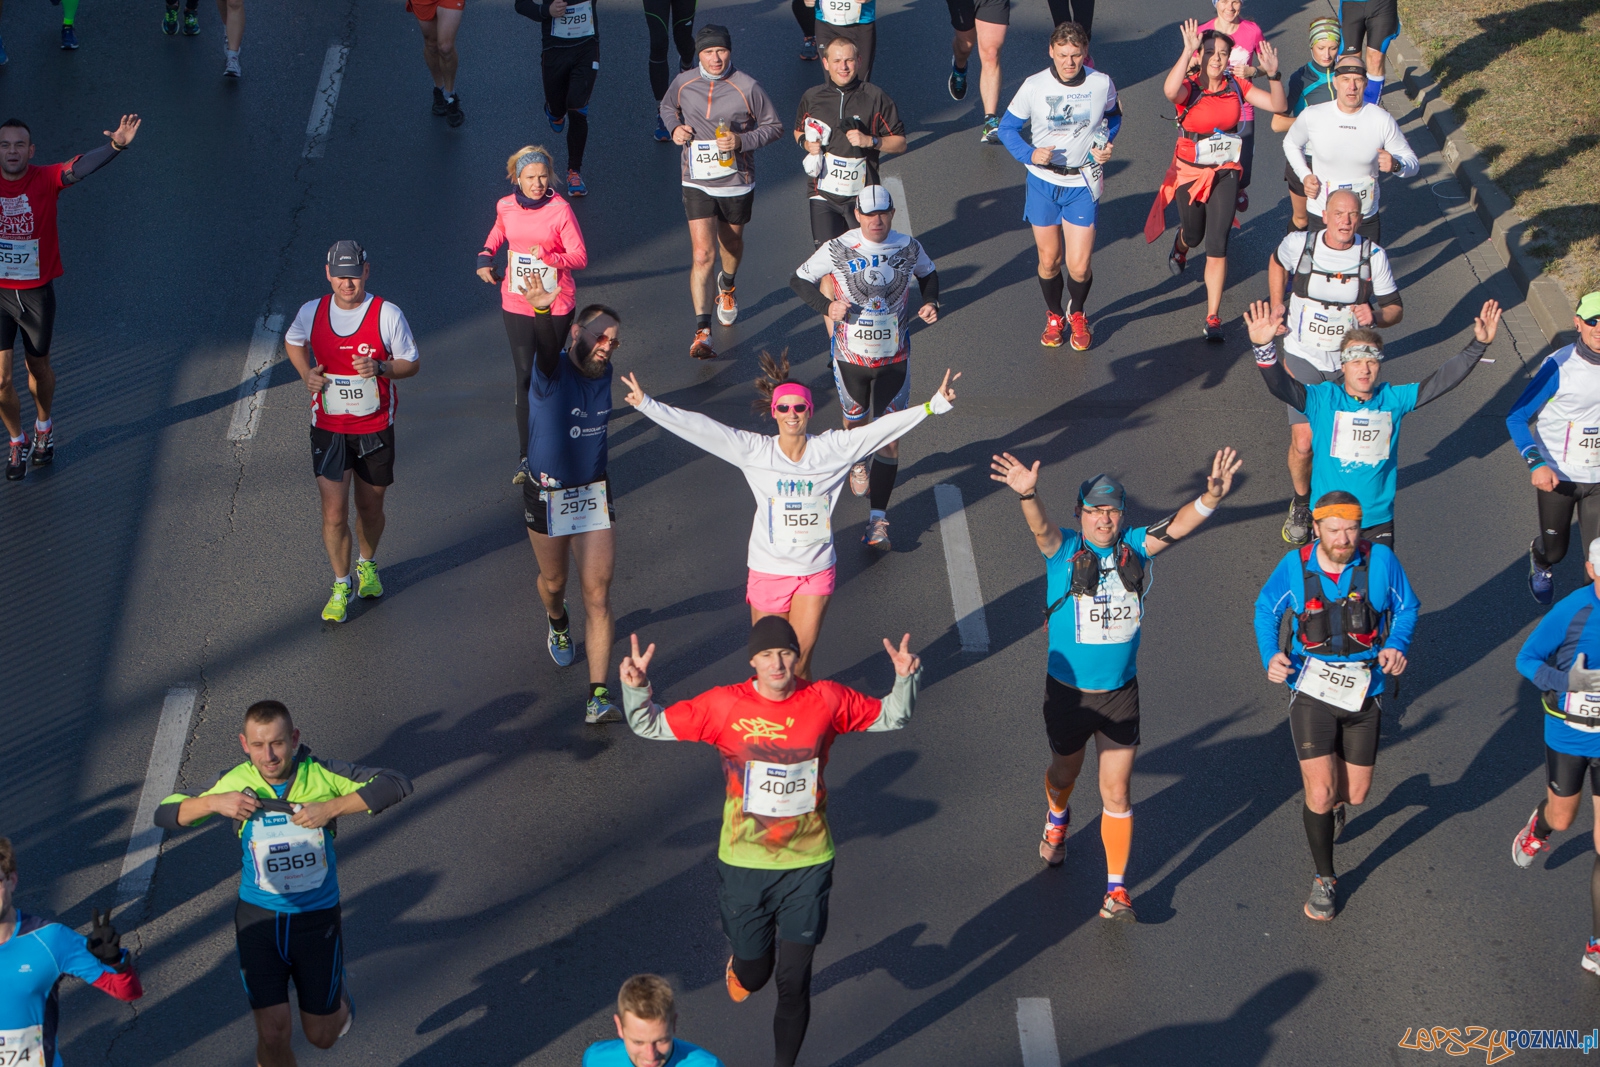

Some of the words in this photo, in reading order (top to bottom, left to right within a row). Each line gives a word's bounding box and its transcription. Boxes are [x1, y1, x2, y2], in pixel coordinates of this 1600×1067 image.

[830, 1, 851, 11] 929
[560, 14, 587, 25] 3789
[1210, 142, 1232, 153] 1142
[696, 152, 720, 164] 434
[830, 169, 859, 181] 4120
[1309, 321, 1345, 335] 6068
[854, 329, 891, 340] 4803
[339, 389, 364, 400] 918
[1353, 429, 1380, 442] 1187
[560, 498, 597, 515] 2975
[783, 513, 819, 527] 1562
[1089, 606, 1132, 622] 6422
[1319, 668, 1357, 689] 2615
[760, 778, 806, 795] 4003
[274, 816, 286, 824] PKO
[266, 852, 316, 873] 6369
